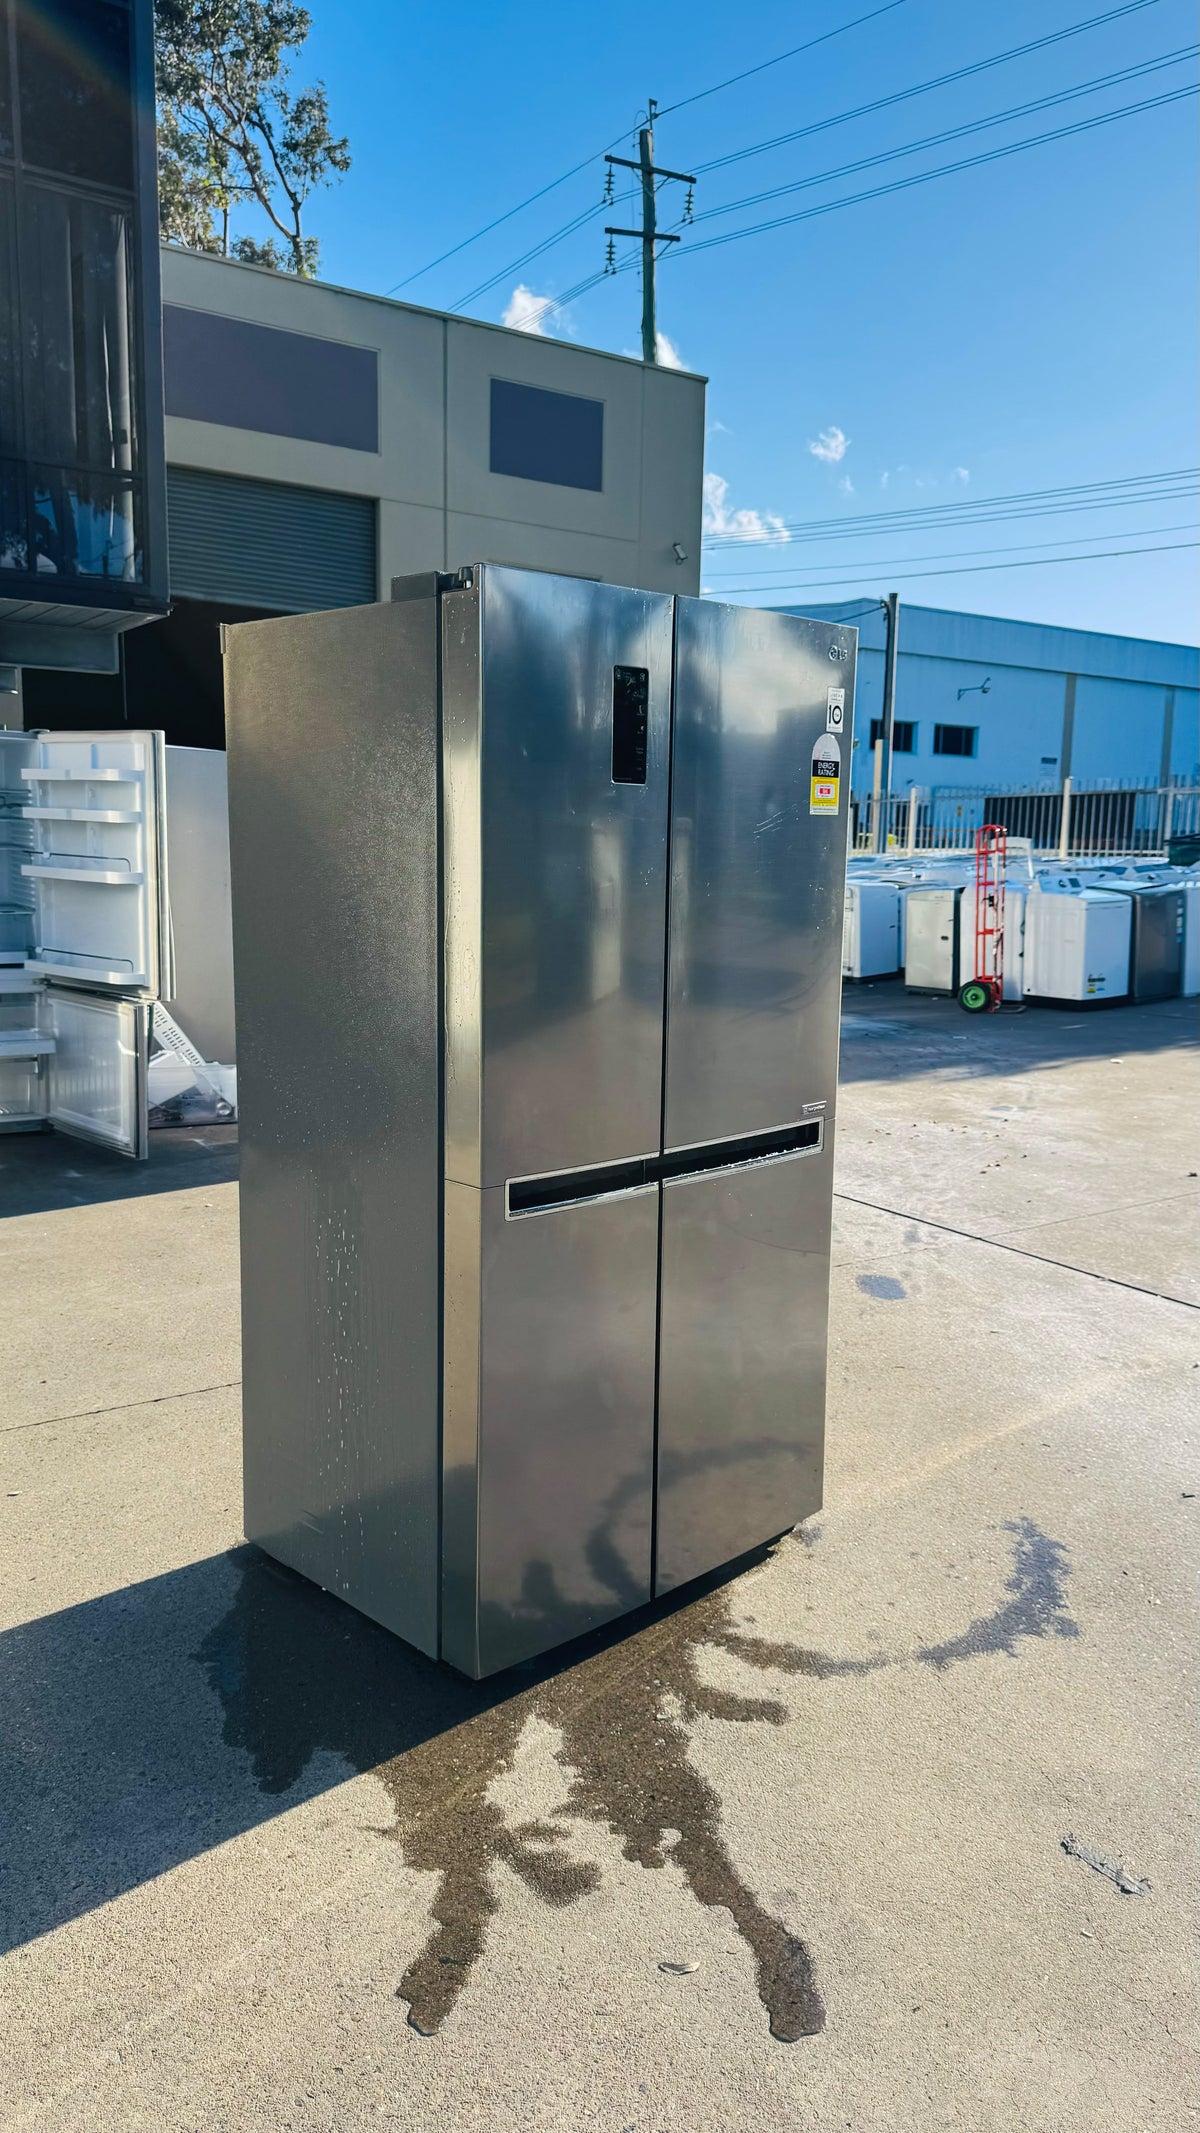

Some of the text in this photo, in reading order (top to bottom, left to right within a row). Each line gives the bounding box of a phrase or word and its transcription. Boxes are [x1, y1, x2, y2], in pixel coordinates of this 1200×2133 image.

[828, 704, 843, 725] 10
[818, 761, 835, 770] ENERGY
[818, 768, 835, 776] RATING
